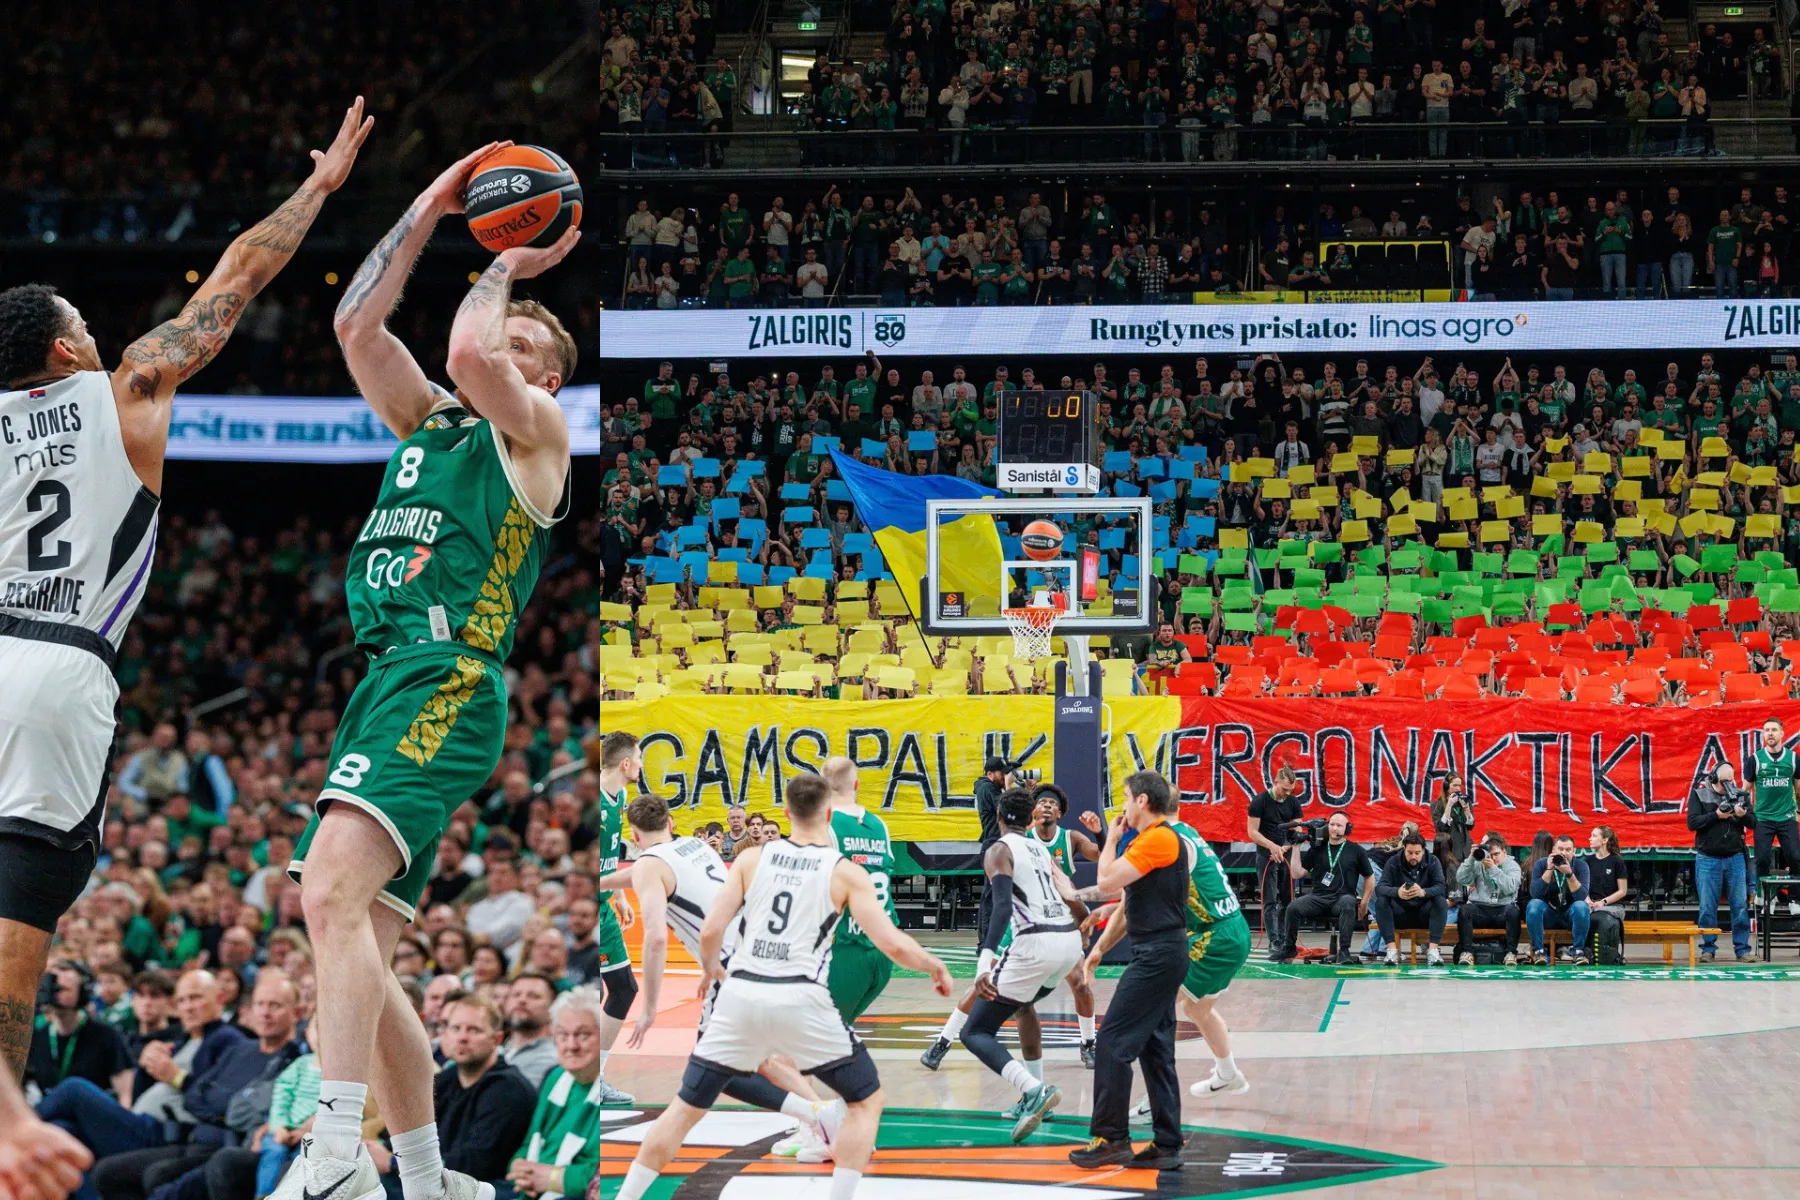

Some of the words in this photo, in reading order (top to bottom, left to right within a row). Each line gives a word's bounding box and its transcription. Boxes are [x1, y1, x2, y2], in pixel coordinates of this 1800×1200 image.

[478, 187, 509, 203] TURKISH
[473, 205, 541, 243] SPALDIN
[875, 322, 905, 341] 80
[1090, 318, 1235, 347] Rungtynes
[1240, 316, 1357, 346] pristato:
[1442, 318, 1514, 344] agro
[1, 414, 22, 445] C.
[28, 402, 82, 440] JONES
[15, 440, 77, 475] mts
[396, 446, 424, 488] 8
[27, 479, 71, 572] 2
[329, 753, 371, 788] 8
[600, 723, 829, 811] GAMS
[1126, 723, 1356, 808] VERGO
[773, 873, 802, 887] mts
[768, 891, 793, 935] 9
